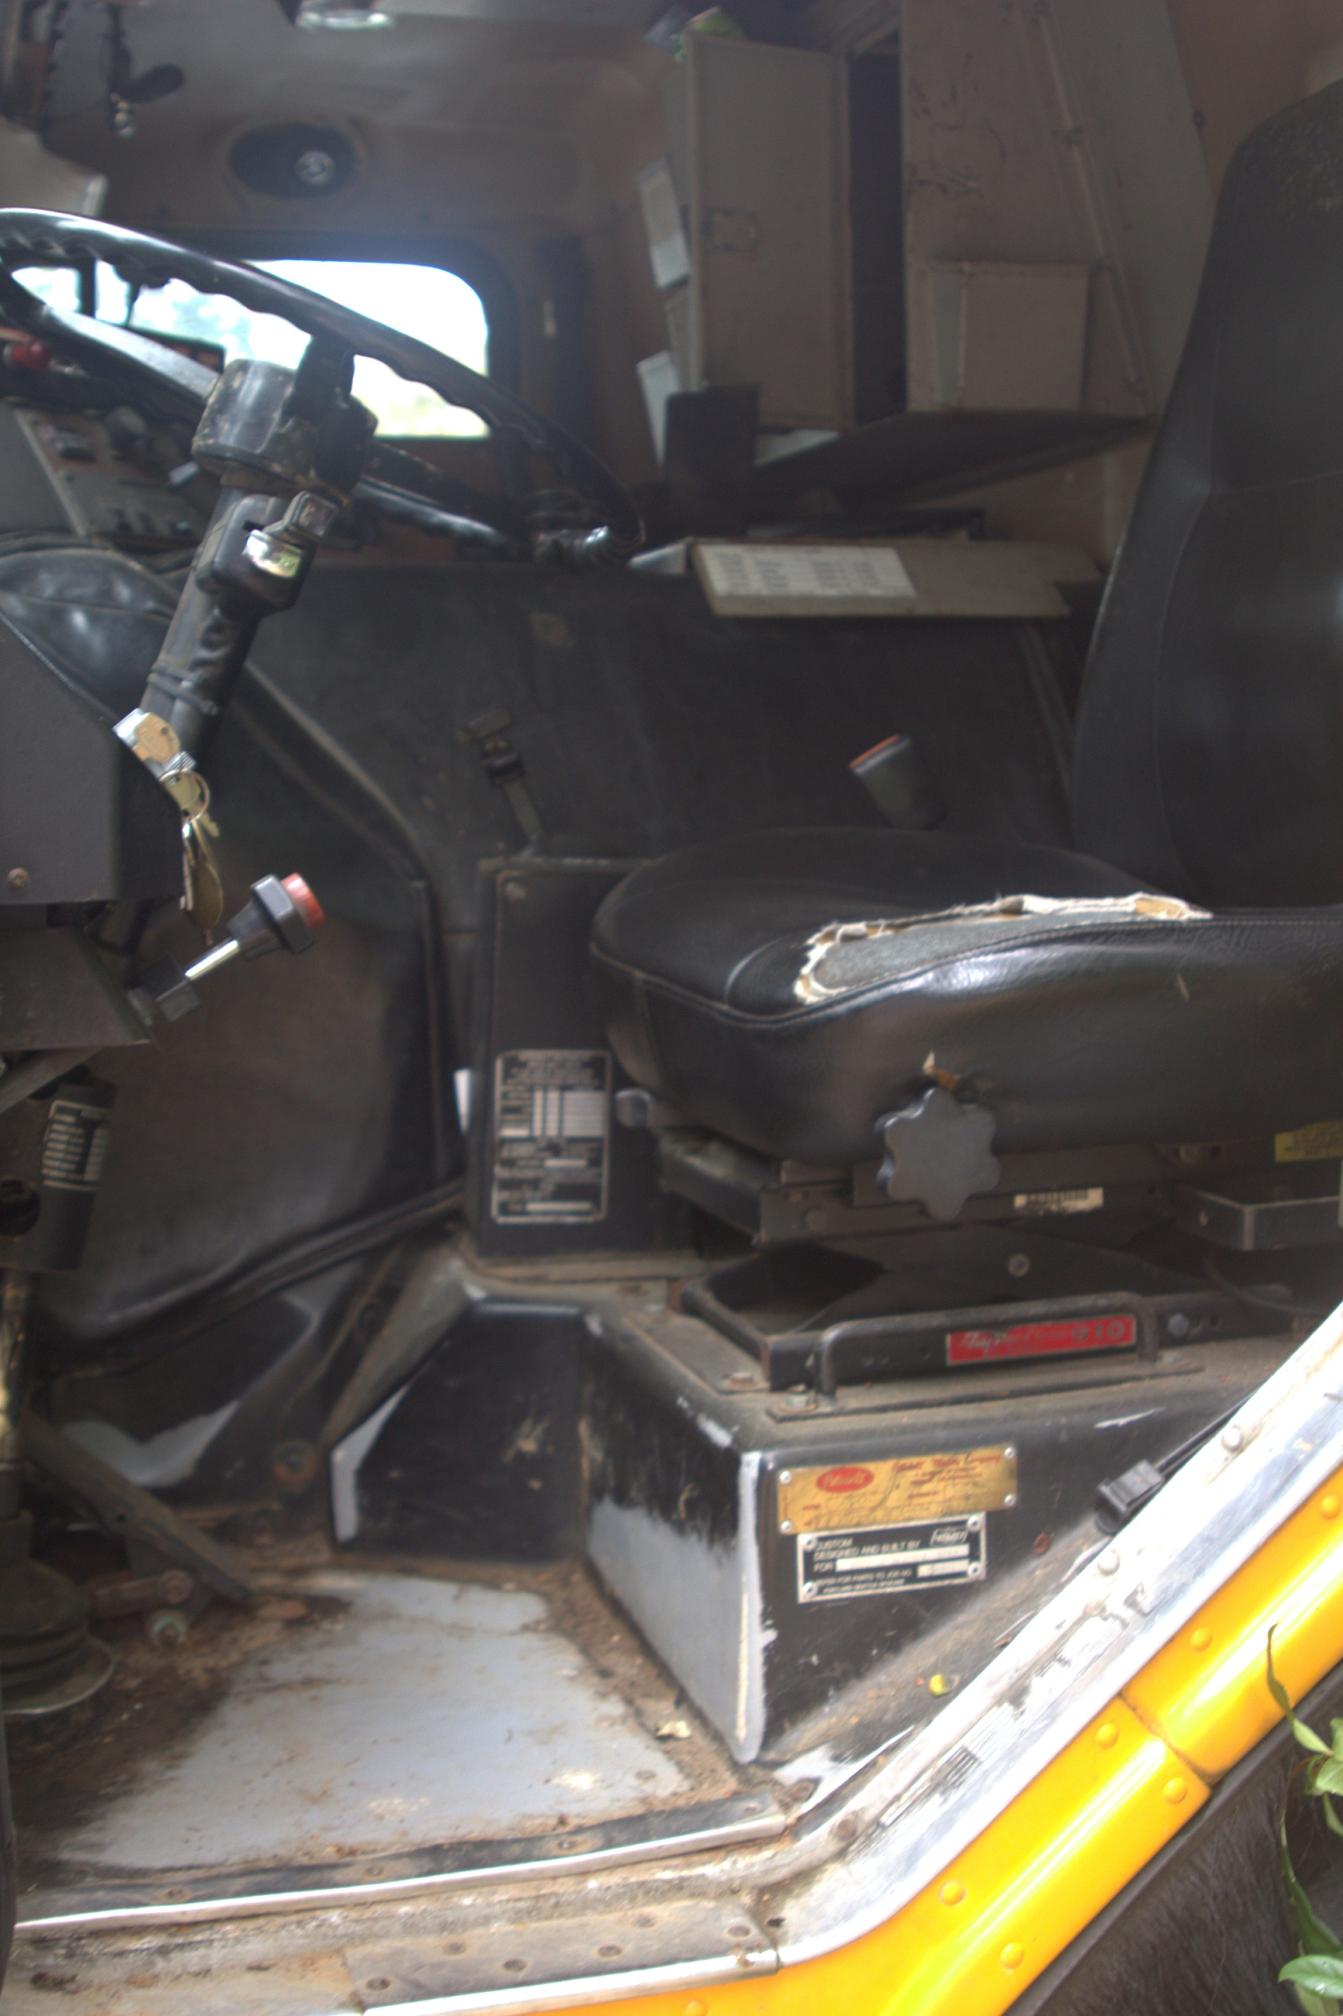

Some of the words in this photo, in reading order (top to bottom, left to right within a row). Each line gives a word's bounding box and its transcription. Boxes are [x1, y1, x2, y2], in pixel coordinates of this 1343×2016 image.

[861, 1544, 881, 1556] AND
[881, 1542, 907, 1554] BUILT
[814, 1562, 833, 1573] FOR
